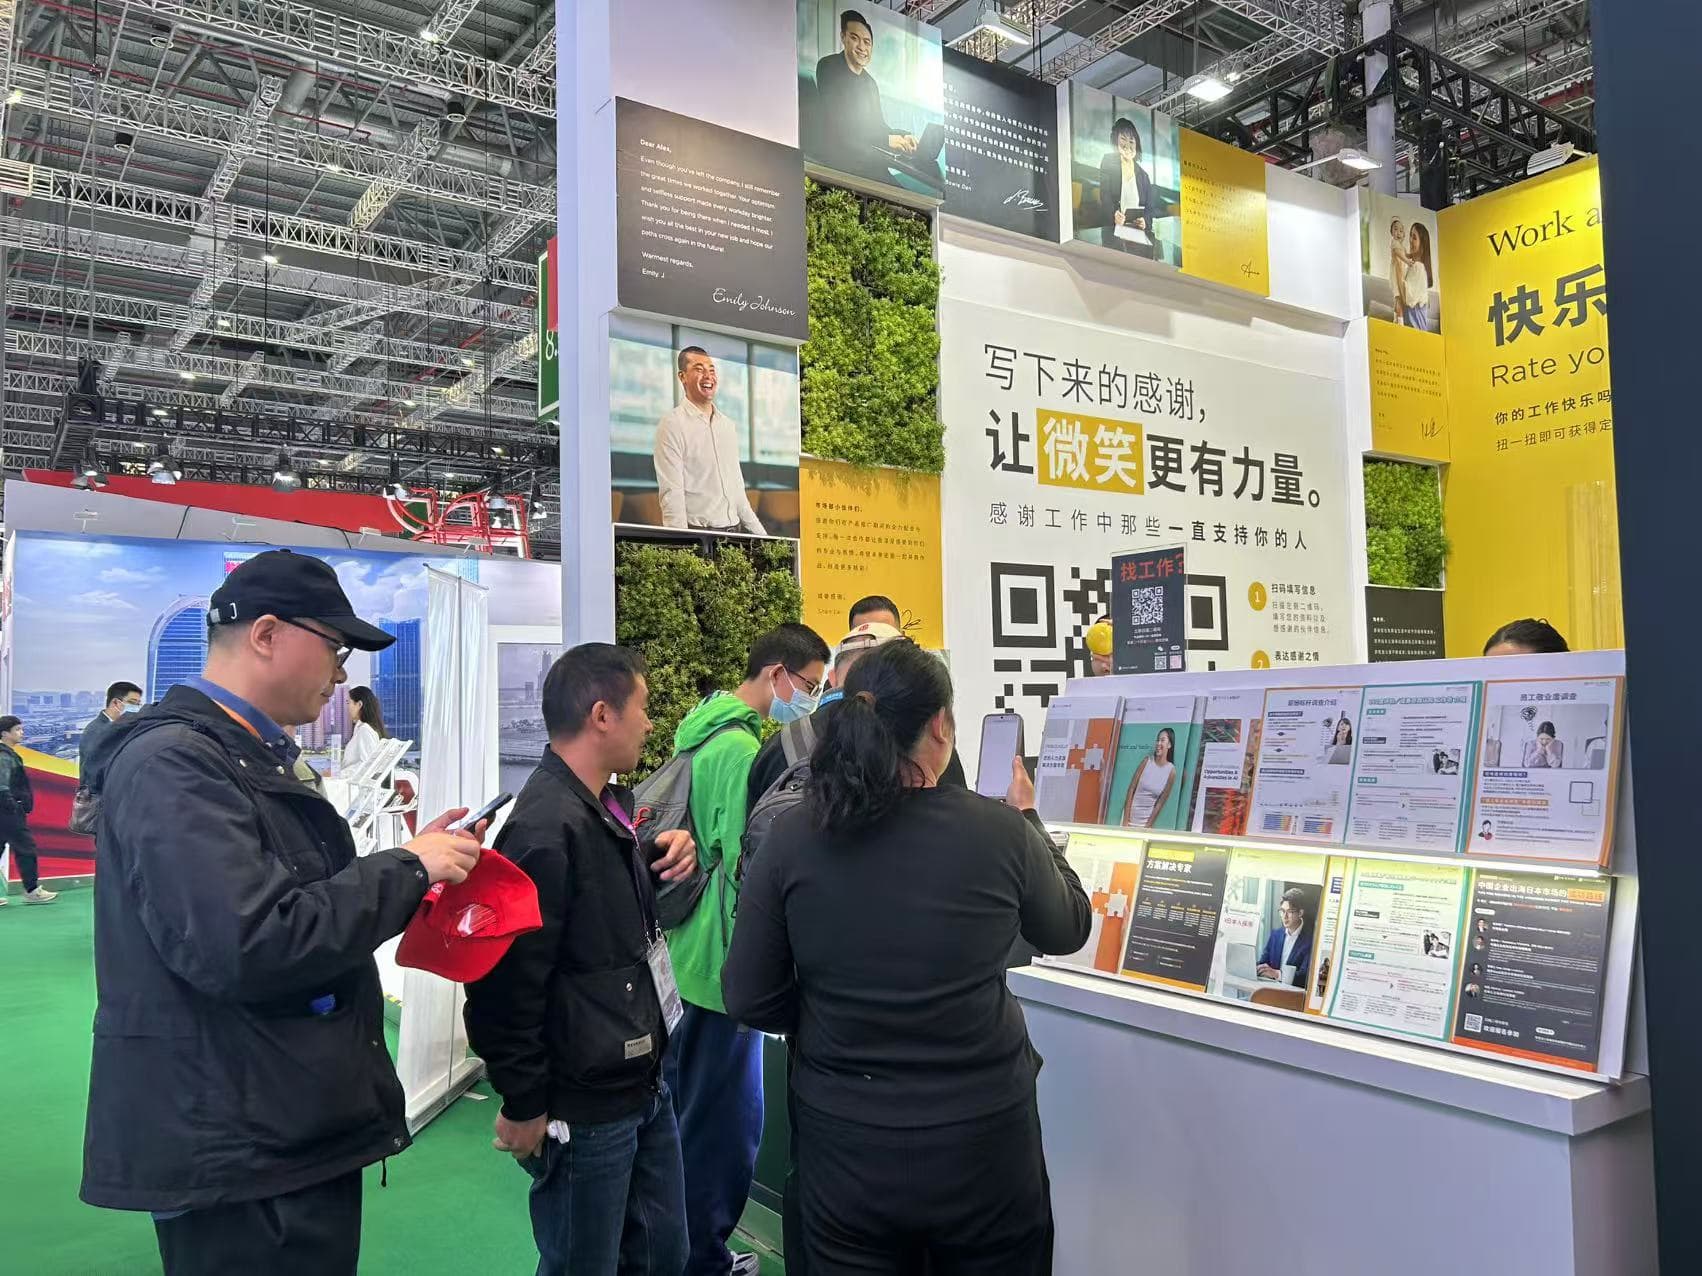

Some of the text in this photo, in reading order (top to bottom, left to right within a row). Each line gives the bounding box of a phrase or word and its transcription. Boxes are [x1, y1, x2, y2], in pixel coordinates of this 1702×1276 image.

[640, 139, 672, 153] Dear Alex,
[1487, 210, 1576, 257] Work
[712, 287, 795, 316] Emily Johnson
[1487, 264, 1606, 347] 快乐
[984, 343, 1207, 424] 写下来的感谢,
[1491, 354, 1557, 387] Rate
[1495, 389, 1612, 425] 你的工作快乐吗
[1497, 419, 1612, 451] 扭一扭即可获得定
[985, 408, 1320, 508] 让微笑更有力量。
[989, 501, 1307, 551] 感谢工作中那些一直支持你的人
